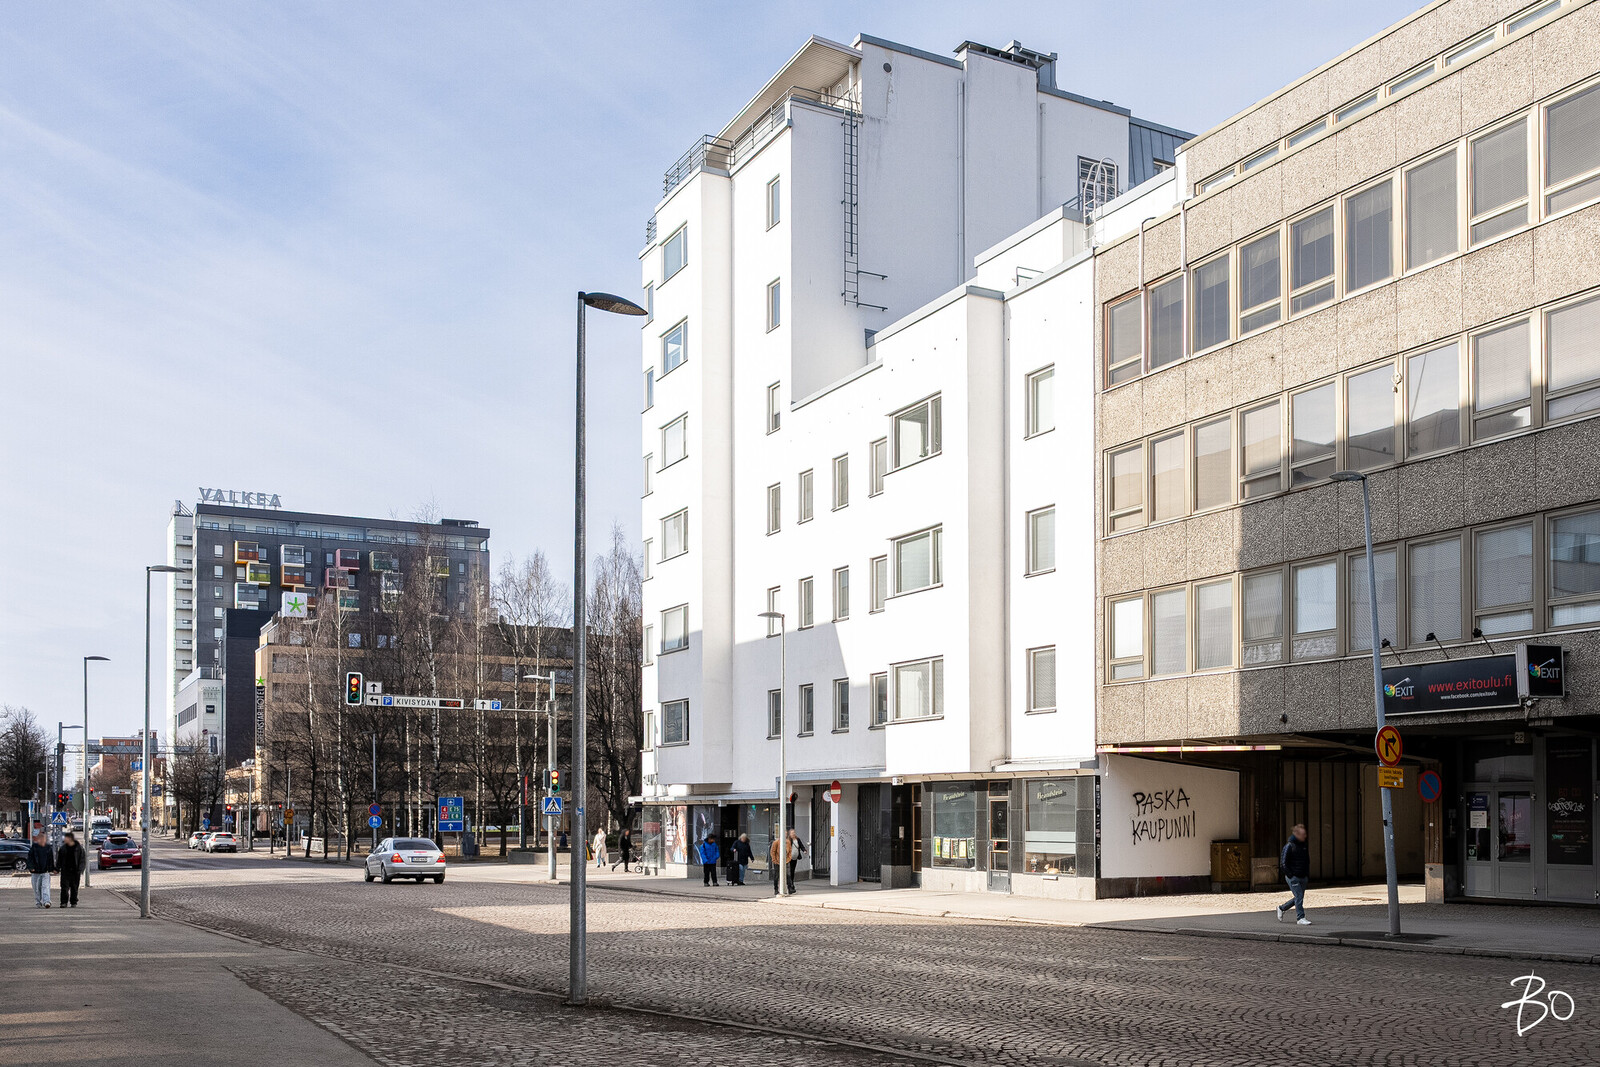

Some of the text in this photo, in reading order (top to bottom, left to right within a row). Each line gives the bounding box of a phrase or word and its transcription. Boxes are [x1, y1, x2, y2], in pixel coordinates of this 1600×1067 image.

[198, 486, 282, 507] VALKEA
[1541, 667, 1561, 679] EXIT
[1395, 685, 1415, 697] EXIT
[1428, 674, 1512, 693] www.exitoulu.fi
[396, 698, 437, 707] KIVISYDÄN
[1132, 788, 1191, 817] PASKA
[1131, 810, 1196, 845] KAUPUNNI
